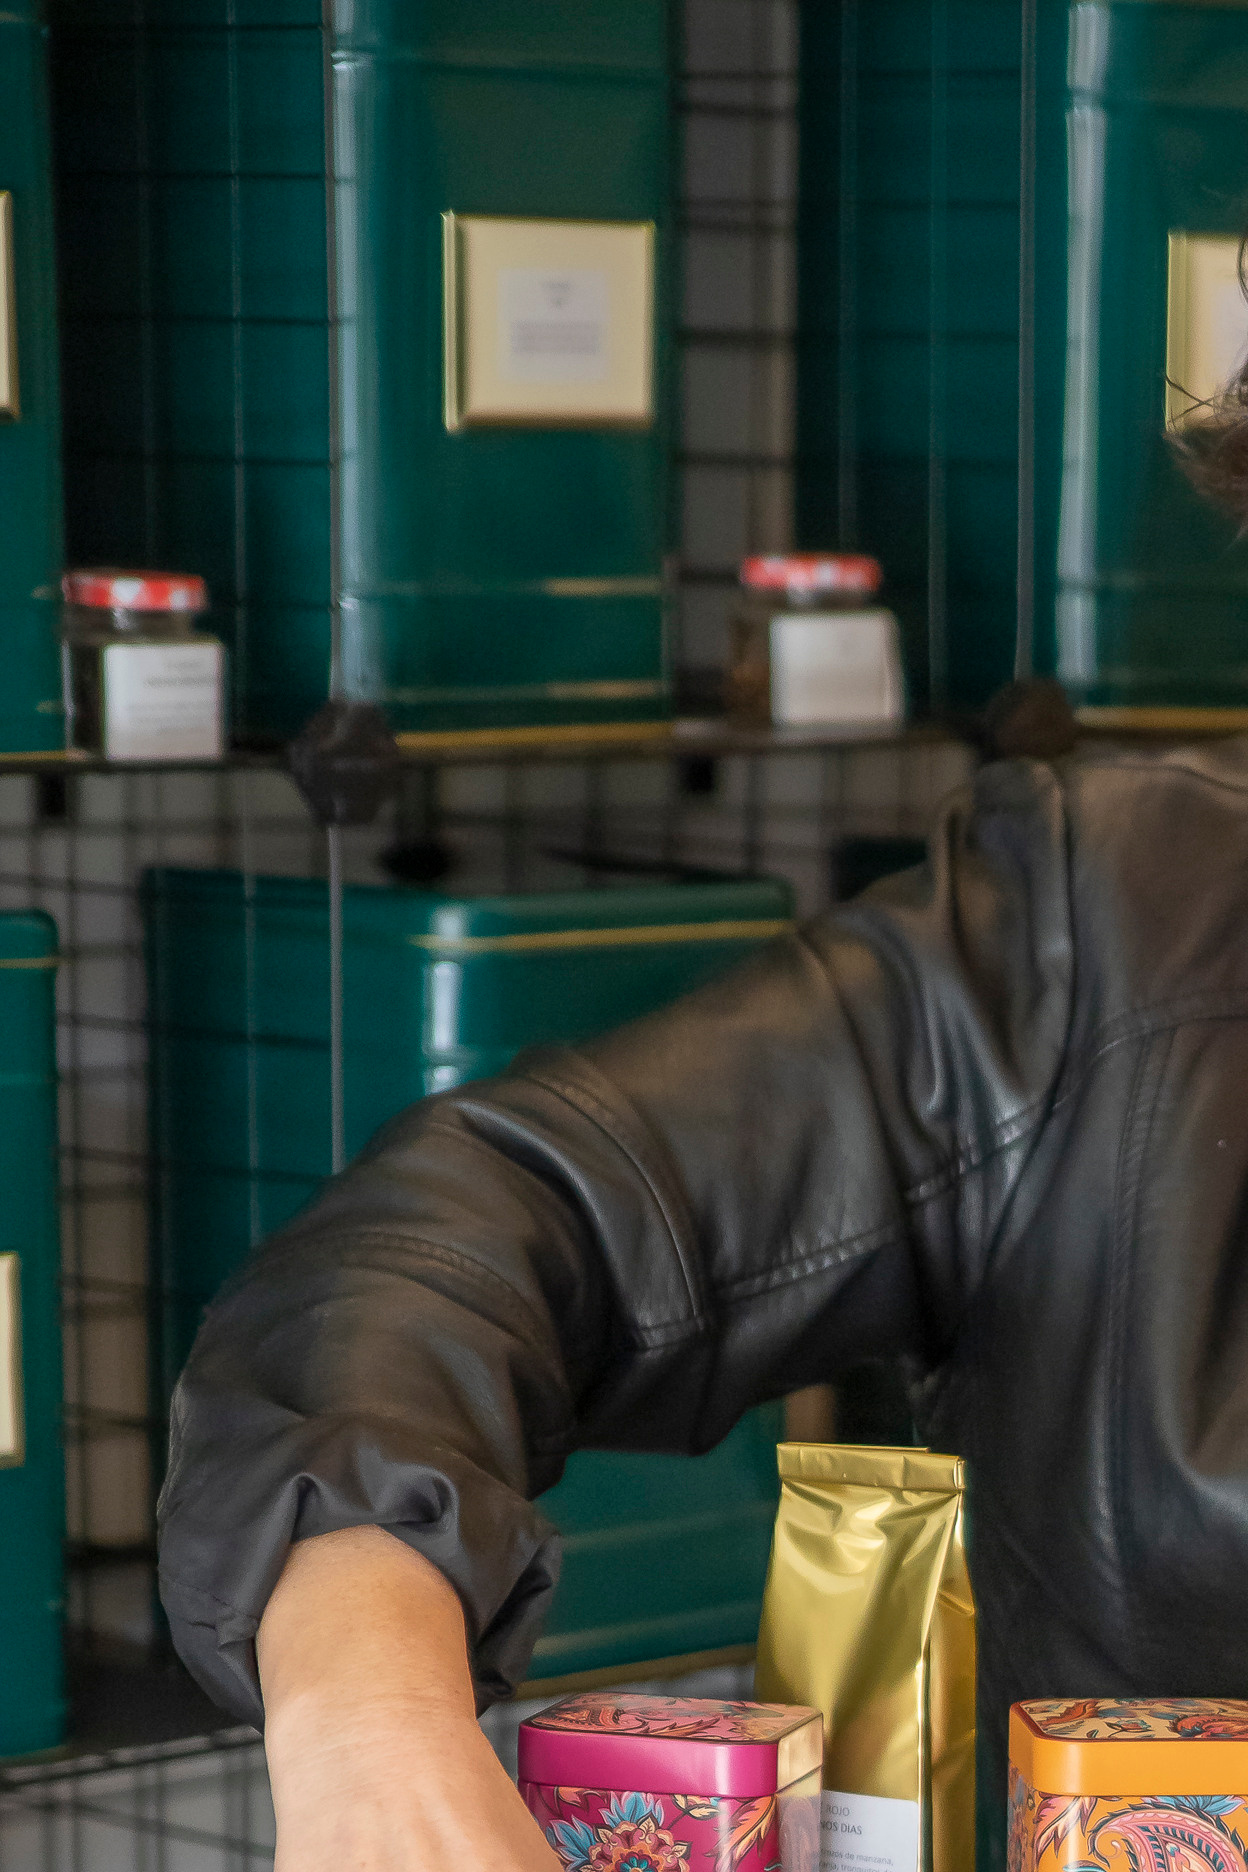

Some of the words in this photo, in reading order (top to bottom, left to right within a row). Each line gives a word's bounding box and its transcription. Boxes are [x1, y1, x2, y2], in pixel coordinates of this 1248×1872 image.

[826, 1804, 850, 1817] ROJO
[840, 1823, 862, 1835] DIAS
[845, 1852, 855, 1861] de
[856, 1854, 893, 1866] manzana,
